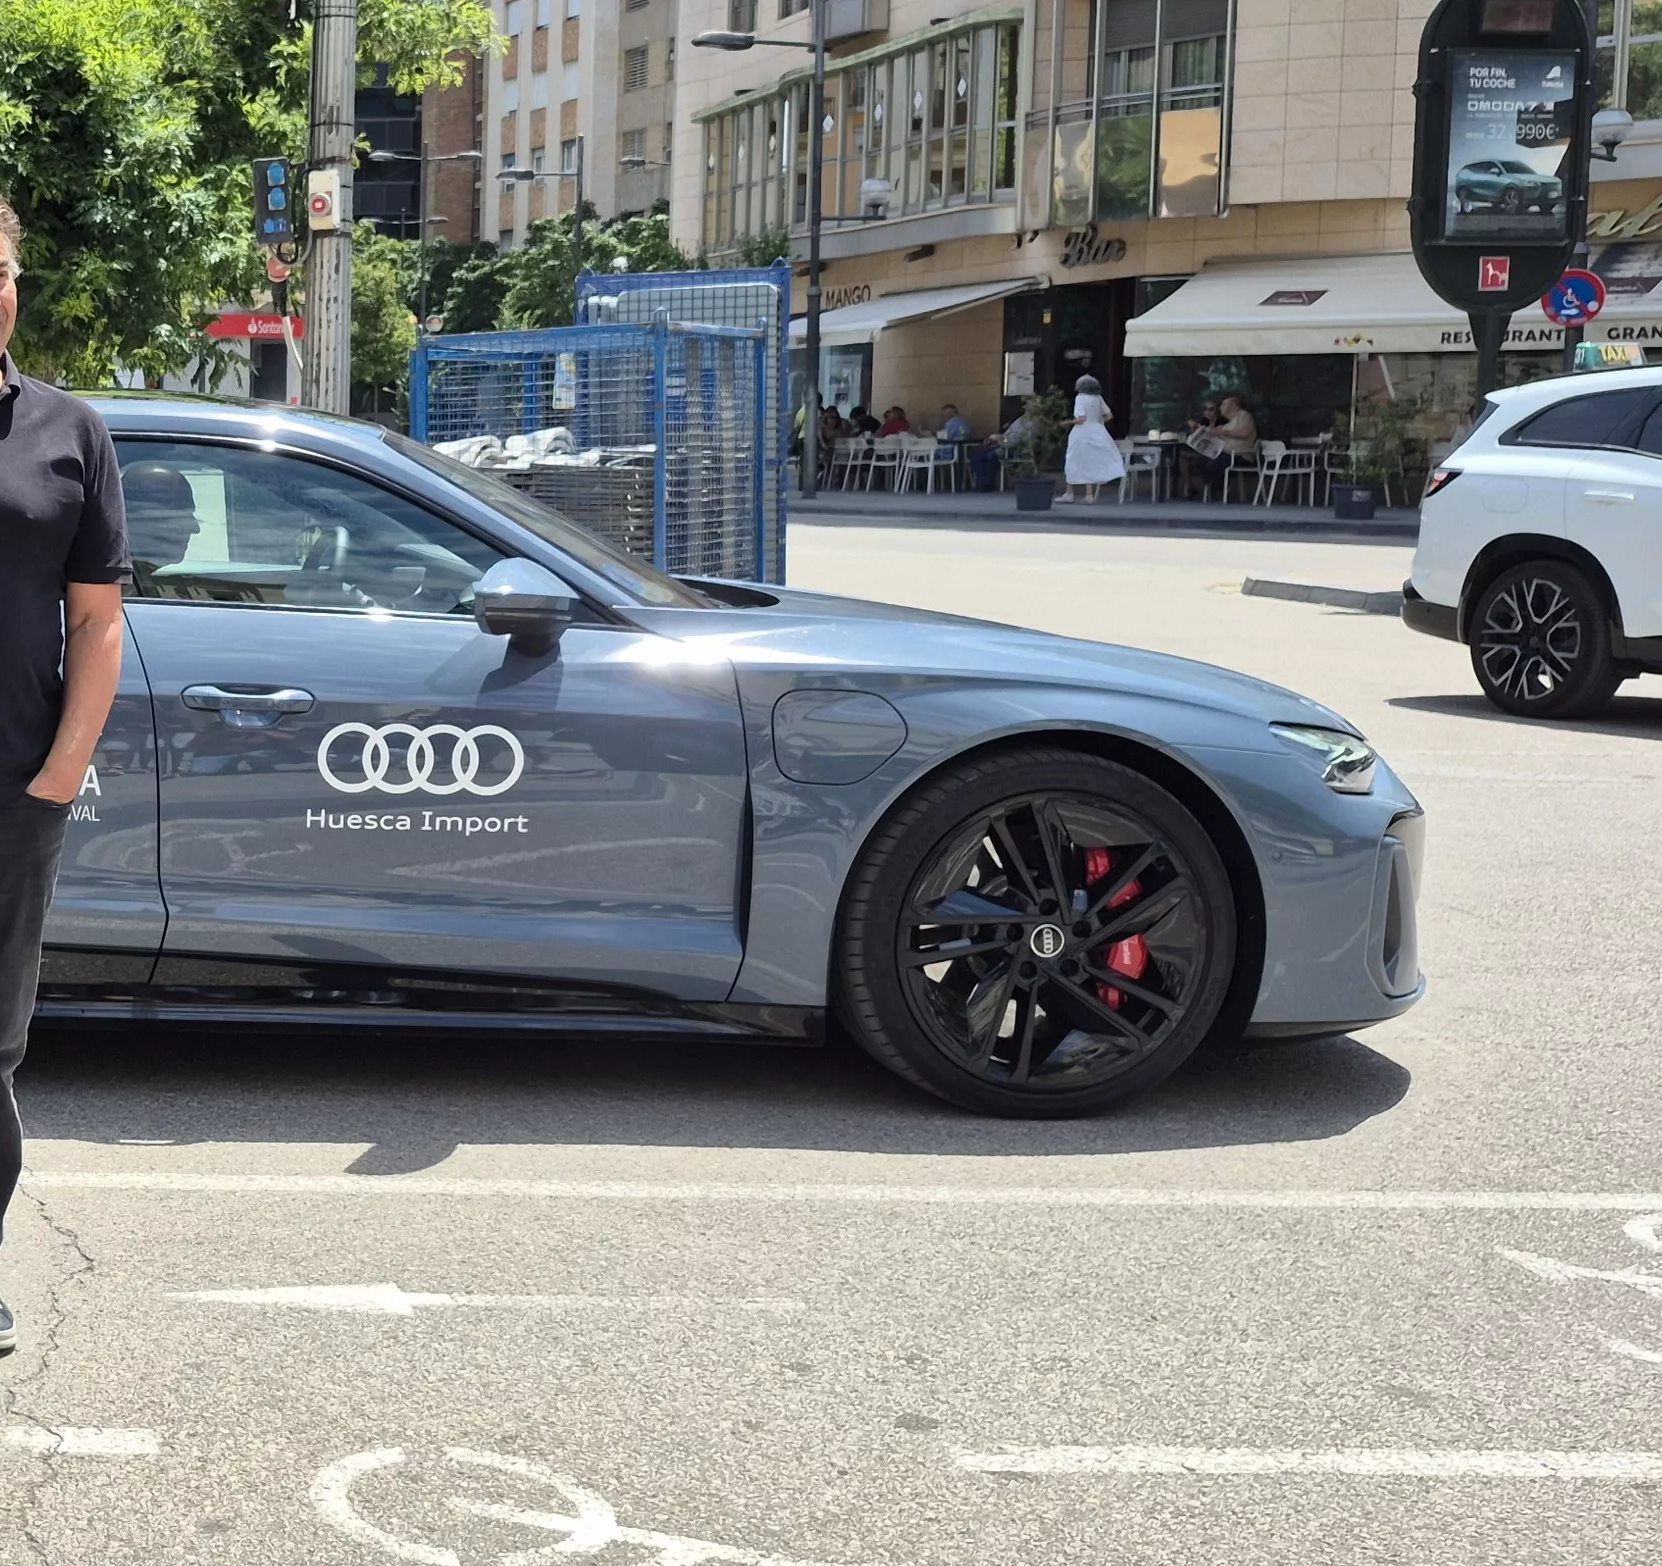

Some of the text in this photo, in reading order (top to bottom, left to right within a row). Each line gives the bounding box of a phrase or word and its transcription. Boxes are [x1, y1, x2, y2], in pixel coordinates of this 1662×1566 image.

[1469, 67, 1489, 77] POR
[1469, 78, 1516, 88] TU COCHE
[1060, 221, 1126, 268] Bar
[825, 285, 871, 309] MANGO
[305, 808, 529, 836] Huesca Import
